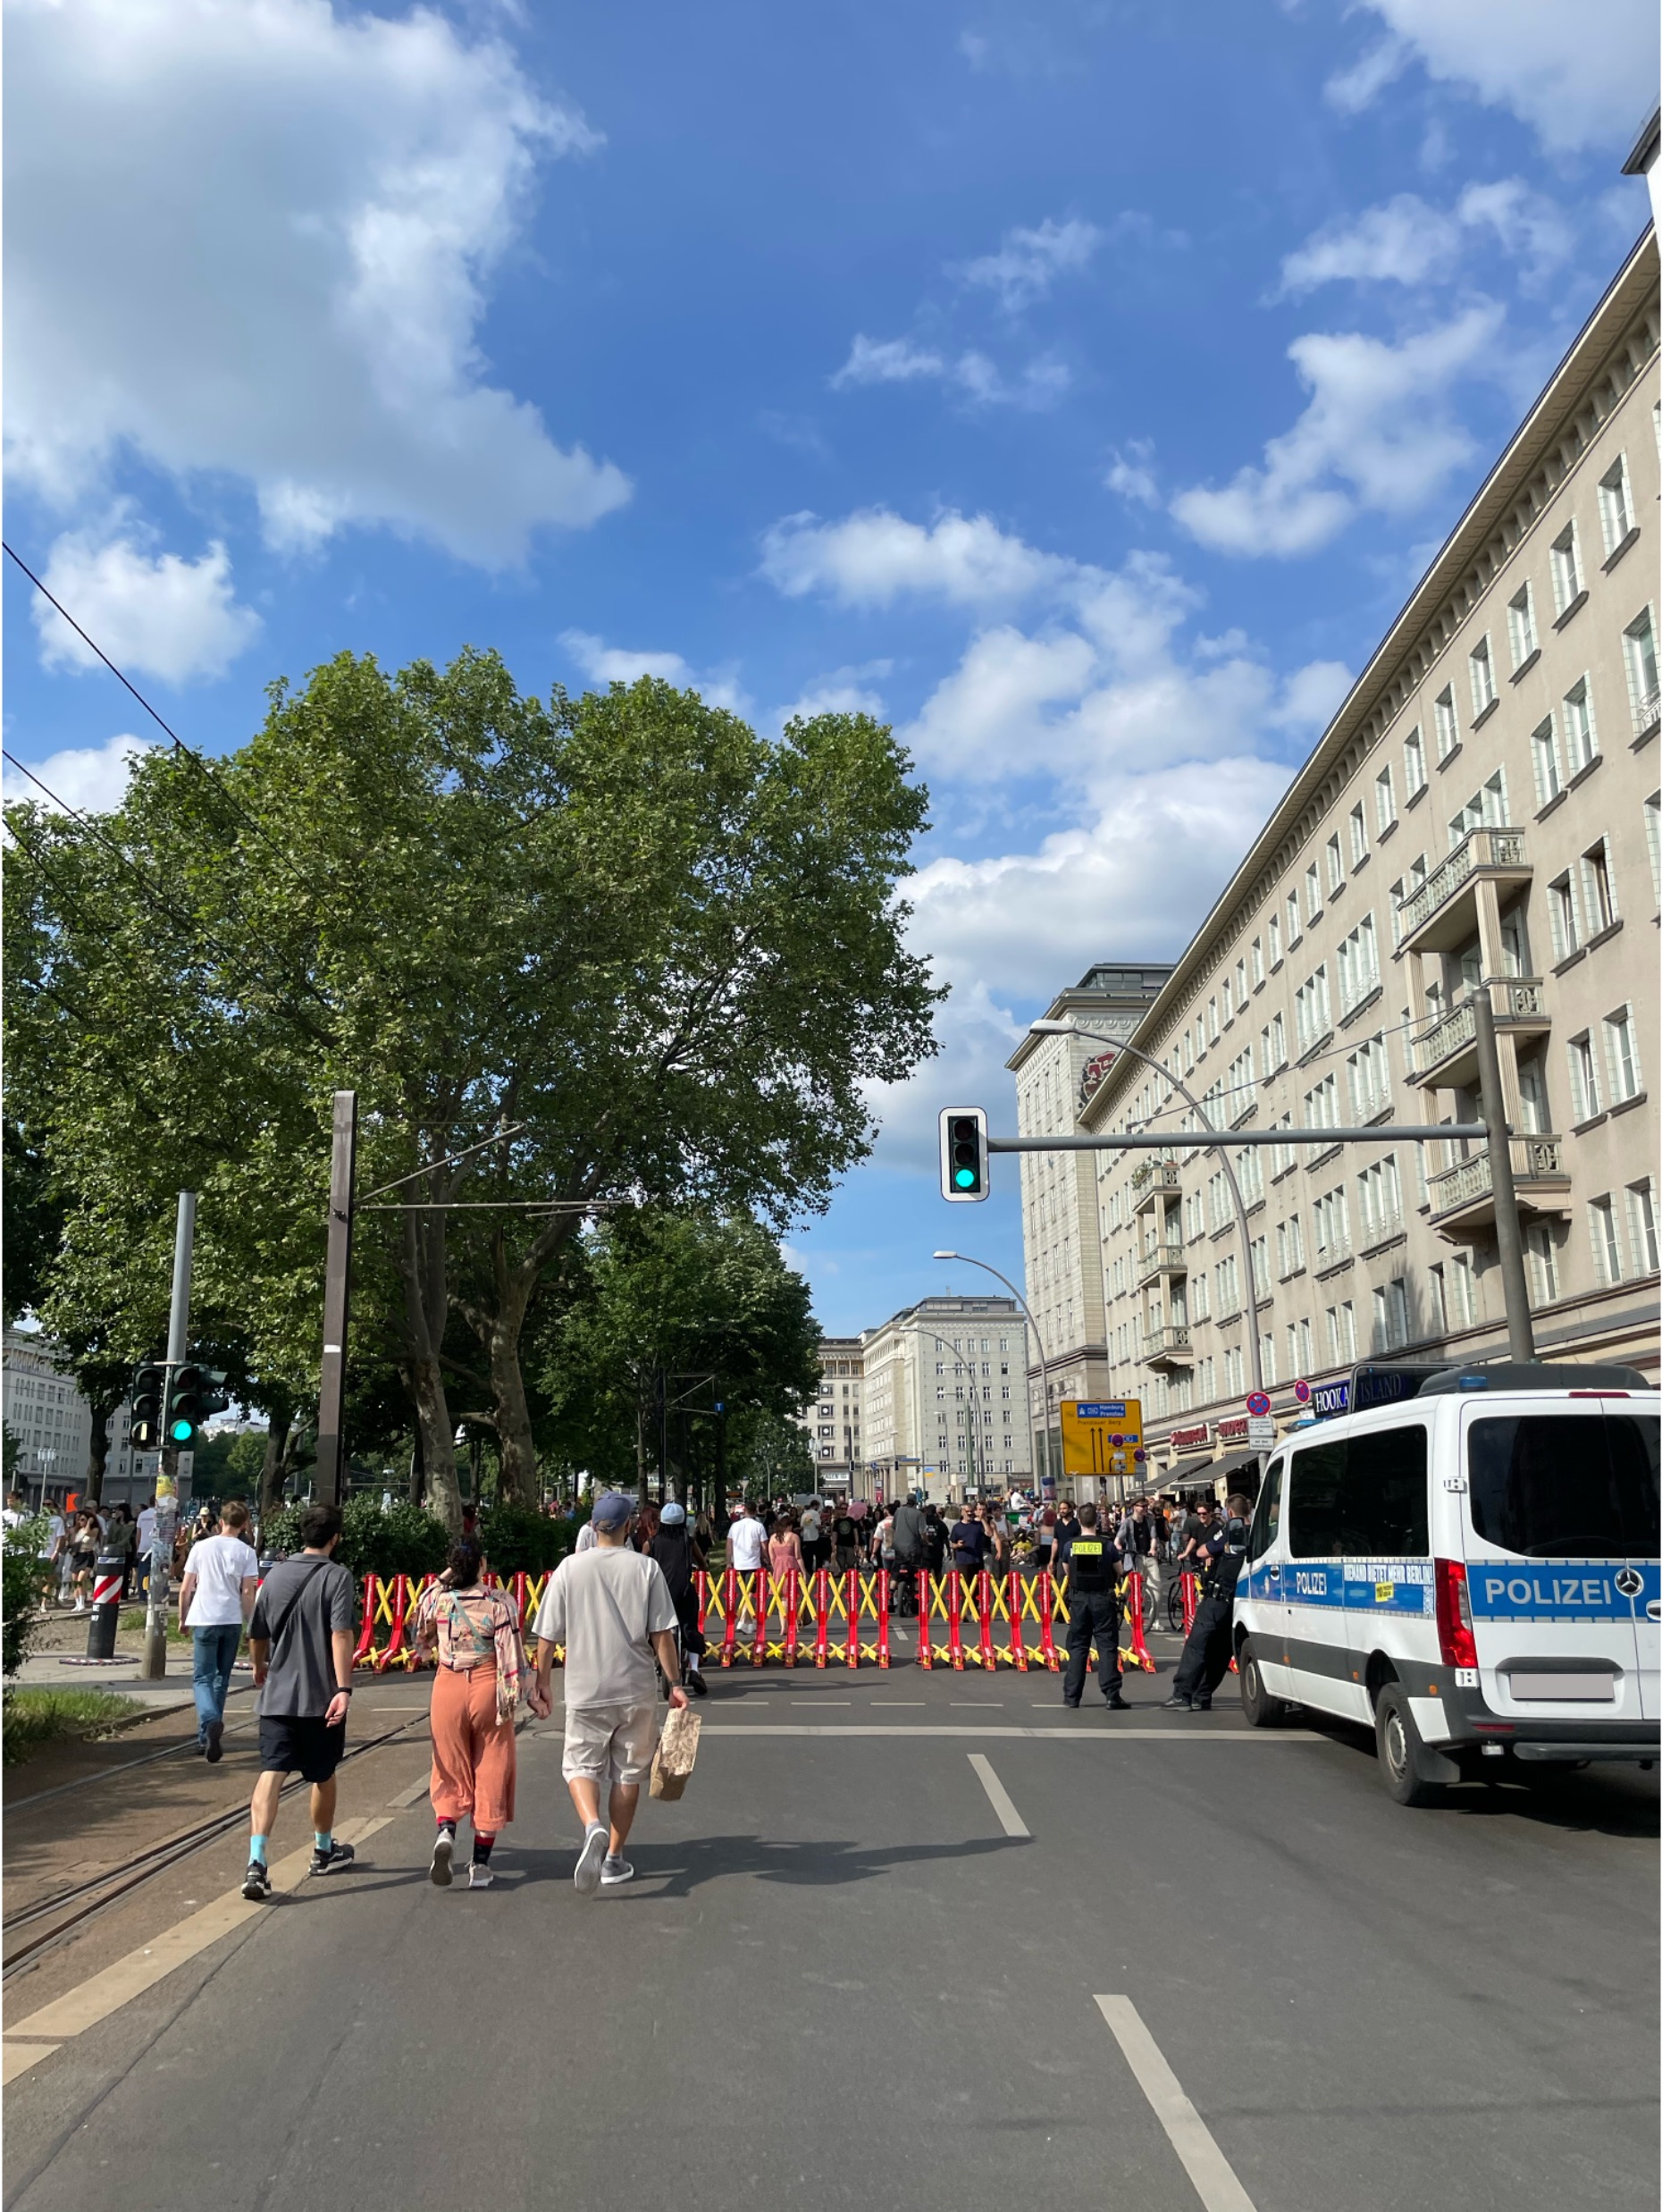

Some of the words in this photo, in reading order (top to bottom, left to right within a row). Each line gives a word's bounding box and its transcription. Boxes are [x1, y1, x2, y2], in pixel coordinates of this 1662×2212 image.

[1360, 1374, 1401, 1402] ISLAND
[1074, 1543, 1101, 1553] POLIZEI
[1297, 1571, 1327, 1596] POLIZEI
[1485, 1578, 1611, 1605] POLIZEI
